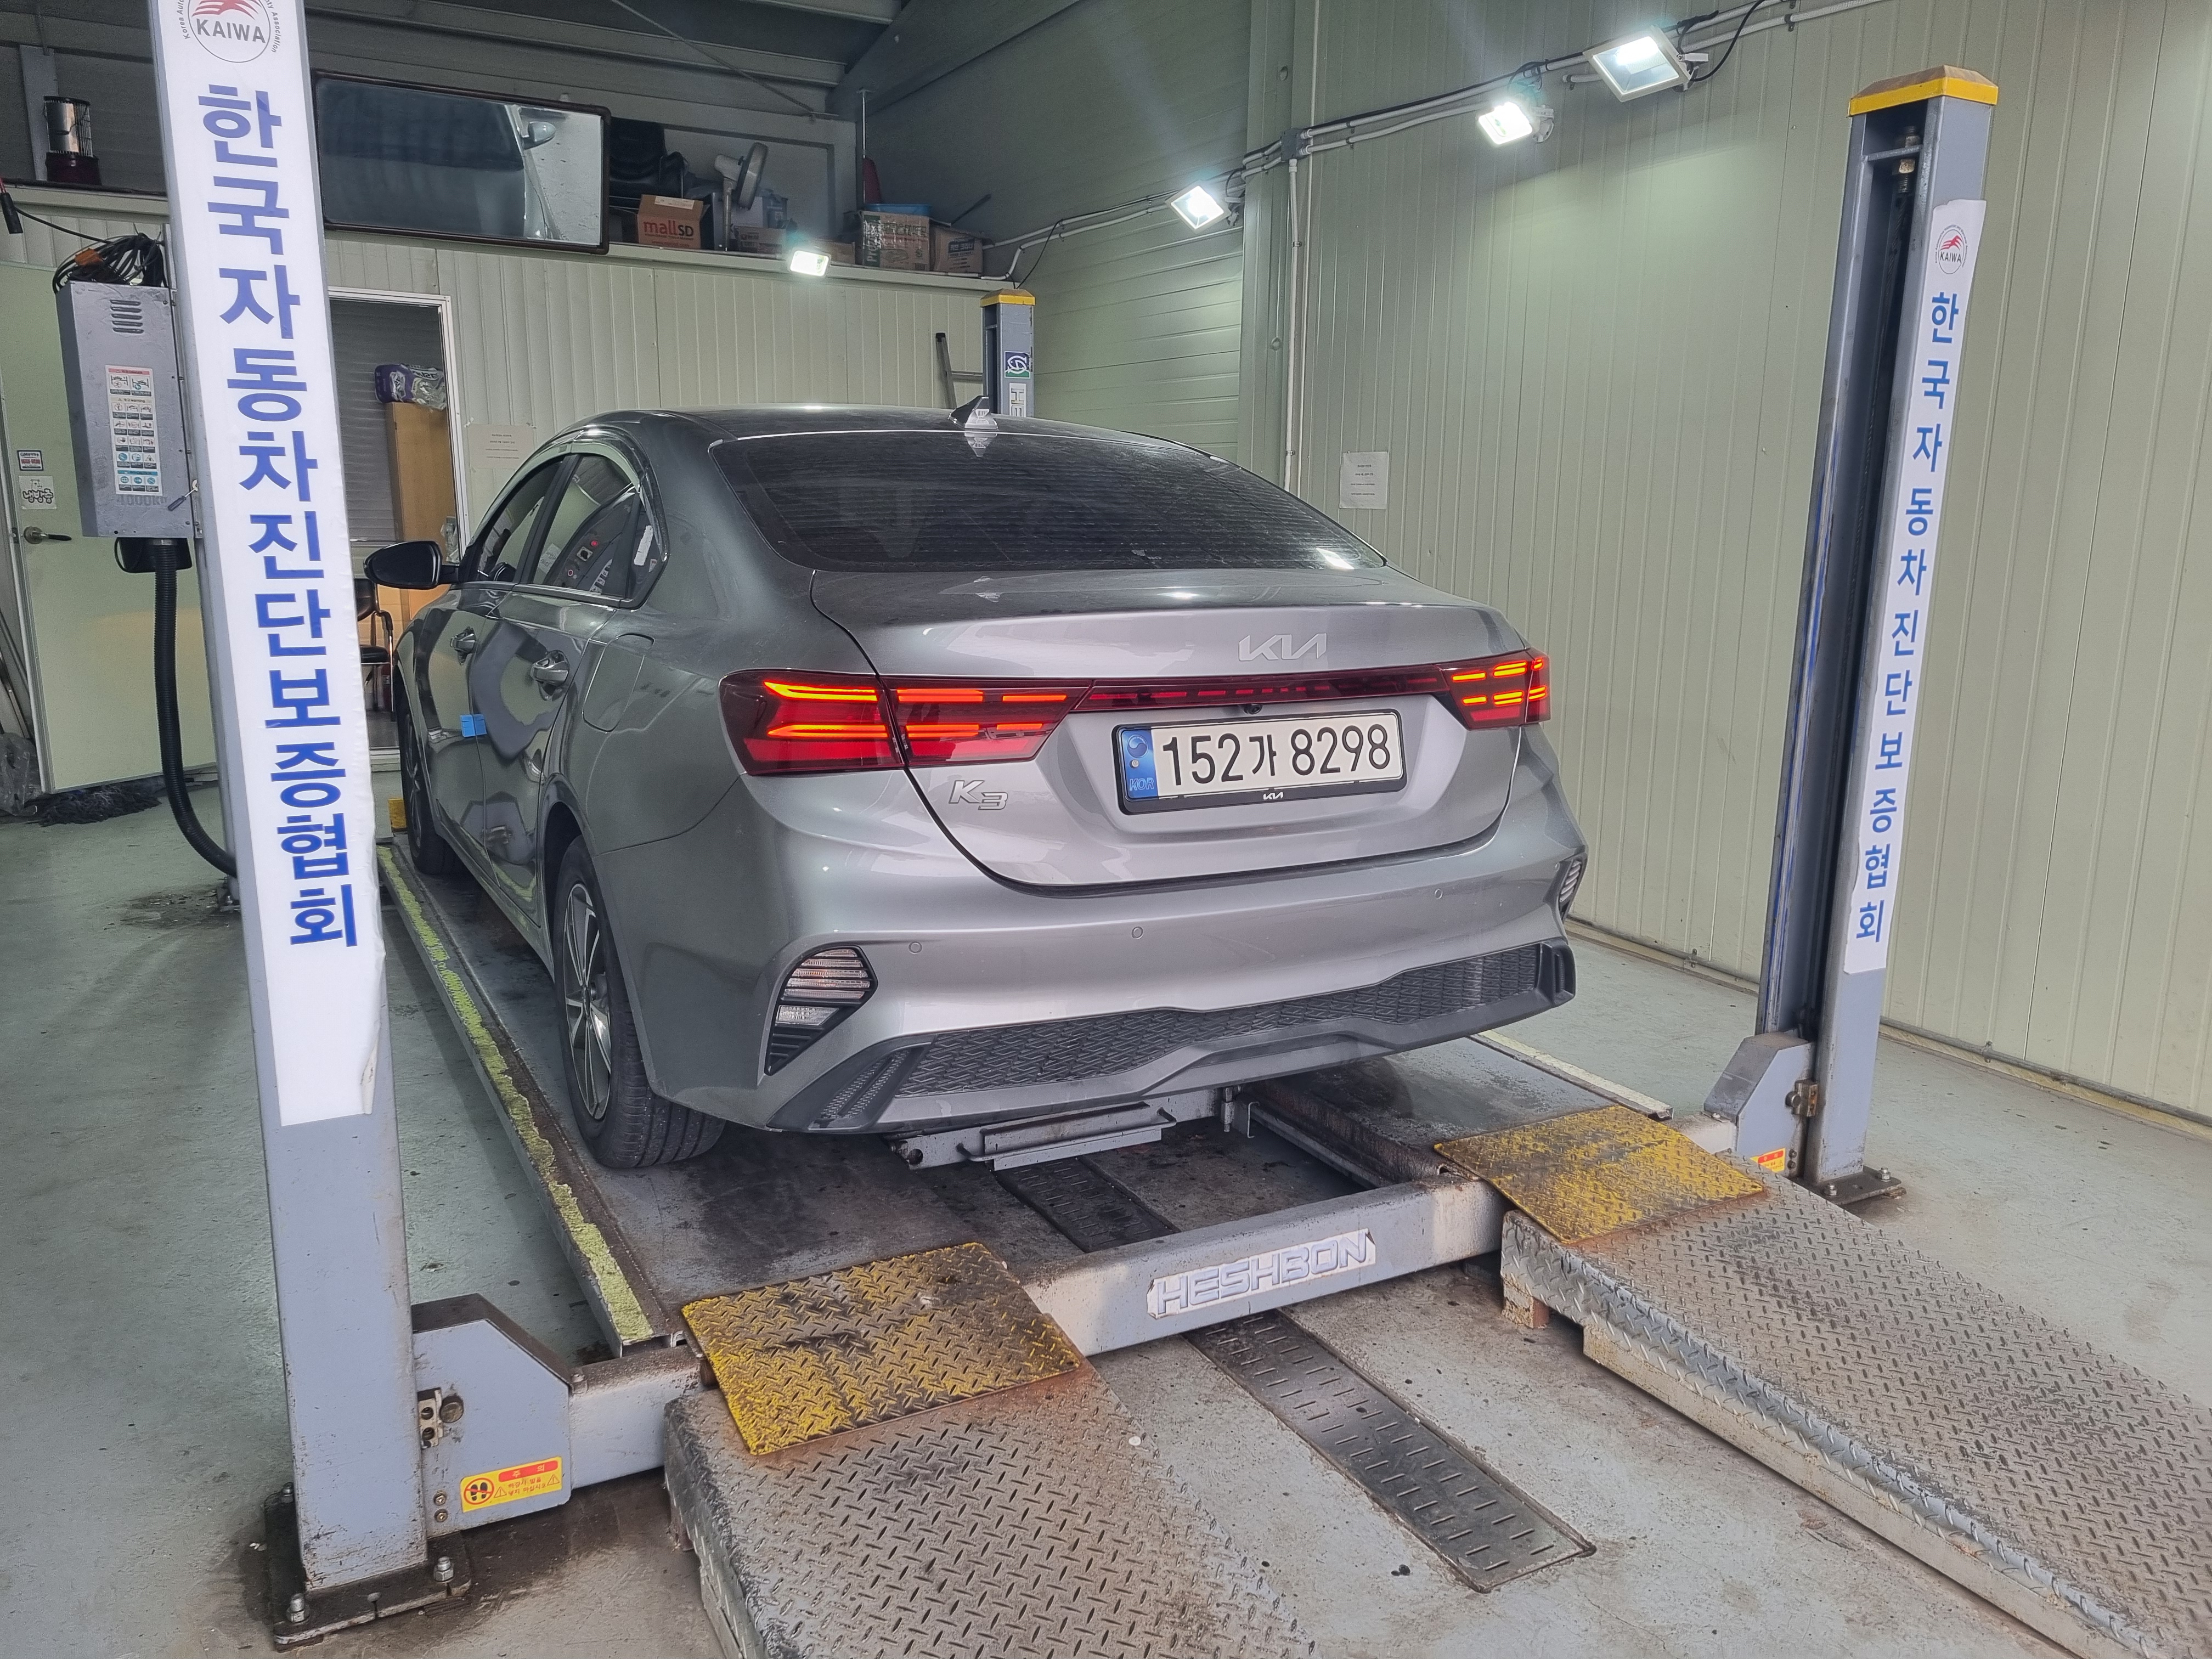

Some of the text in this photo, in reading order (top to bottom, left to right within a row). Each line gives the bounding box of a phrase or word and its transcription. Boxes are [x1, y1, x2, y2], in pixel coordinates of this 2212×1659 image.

[196, 18, 266, 43] KAIWA
[1940, 251, 1962, 263] KAIWA
[198, 84, 358, 947] 한국자동차진단보증협회
[1856, 292, 1959, 943] 한국자동차진단보증협회
[1163, 724, 1391, 786] 152가 8298
[949, 780, 1008, 810] K3
[1130, 777, 1154, 791] KOR
[1156, 1232, 1369, 1314] HESHBON
